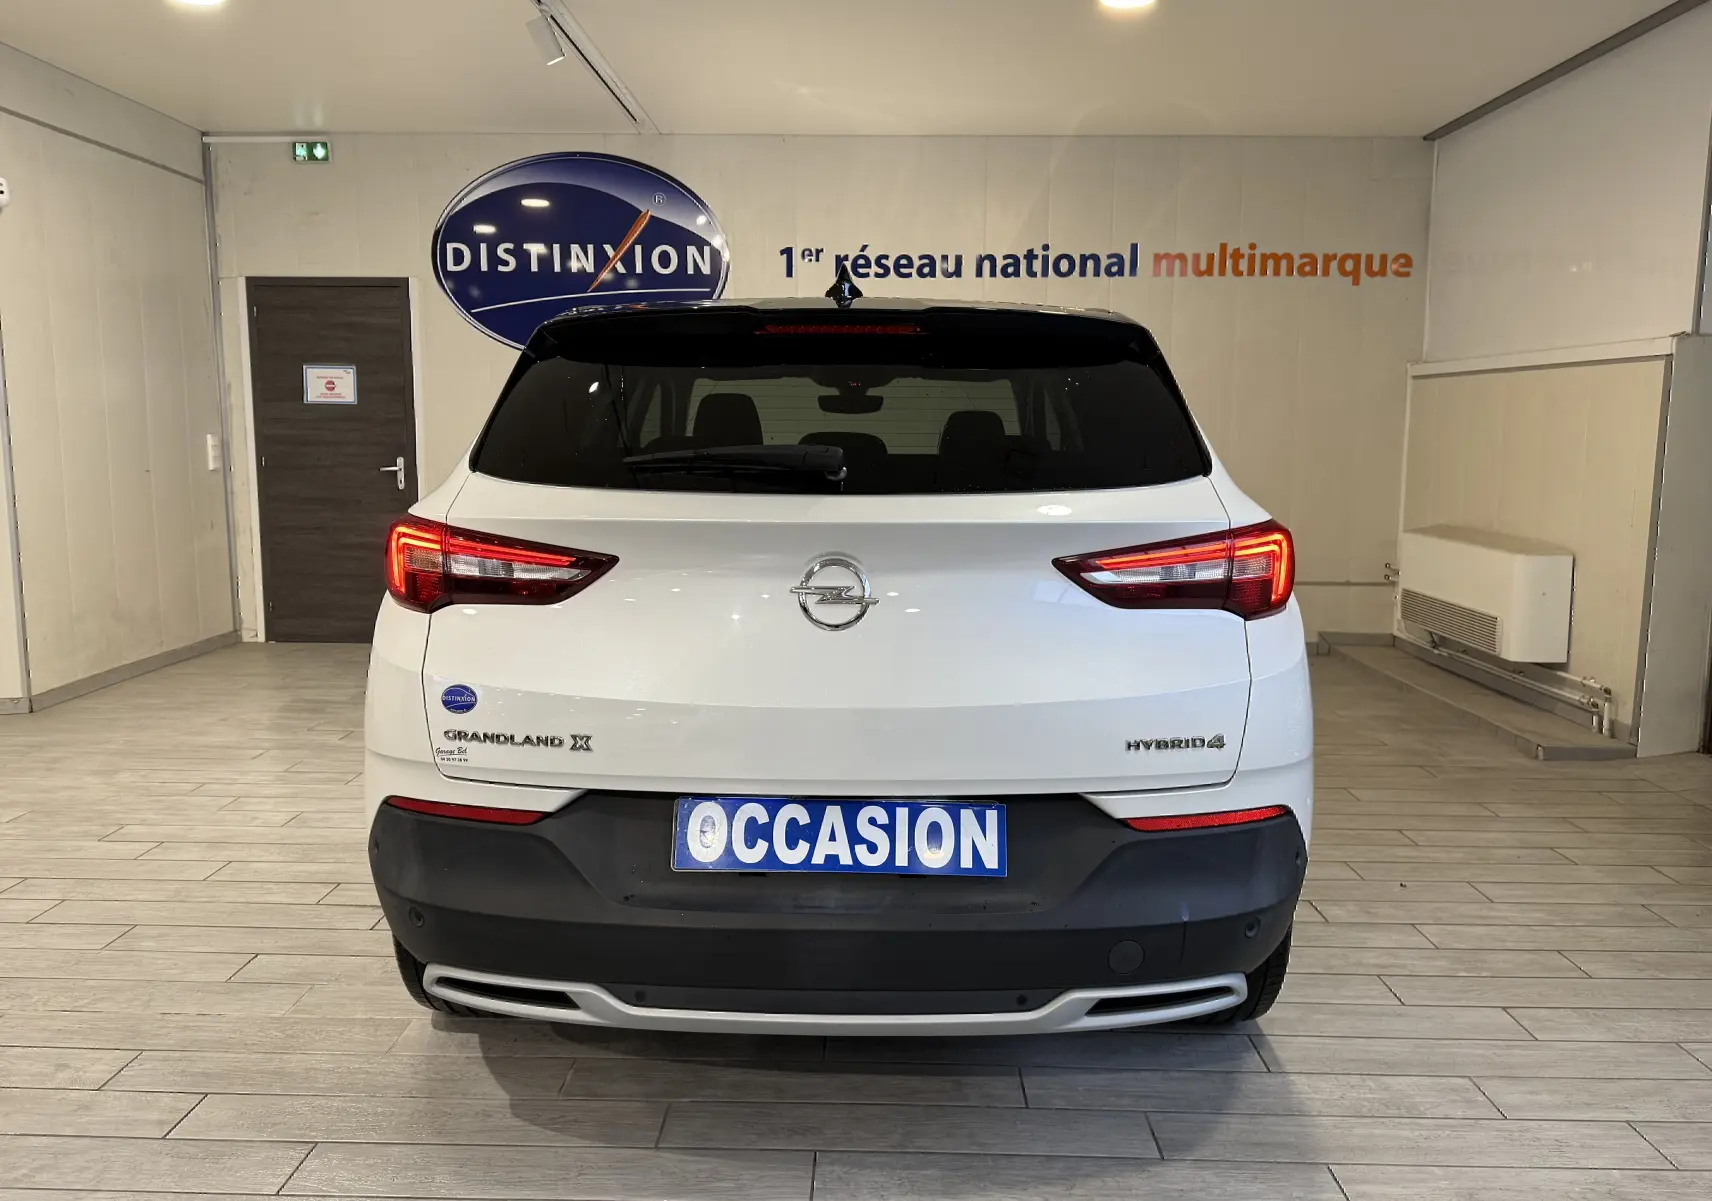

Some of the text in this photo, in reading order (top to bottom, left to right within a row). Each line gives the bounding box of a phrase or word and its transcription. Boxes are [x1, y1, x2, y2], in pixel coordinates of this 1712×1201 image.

[445, 240, 712, 278] DISTINXION
[779, 243, 1413, 286] 1er réseau national multimarque
[443, 729, 593, 752] GRANDLAND X
[1125, 733, 1225, 751] HYBRID4
[687, 801, 999, 869] OCCASION
